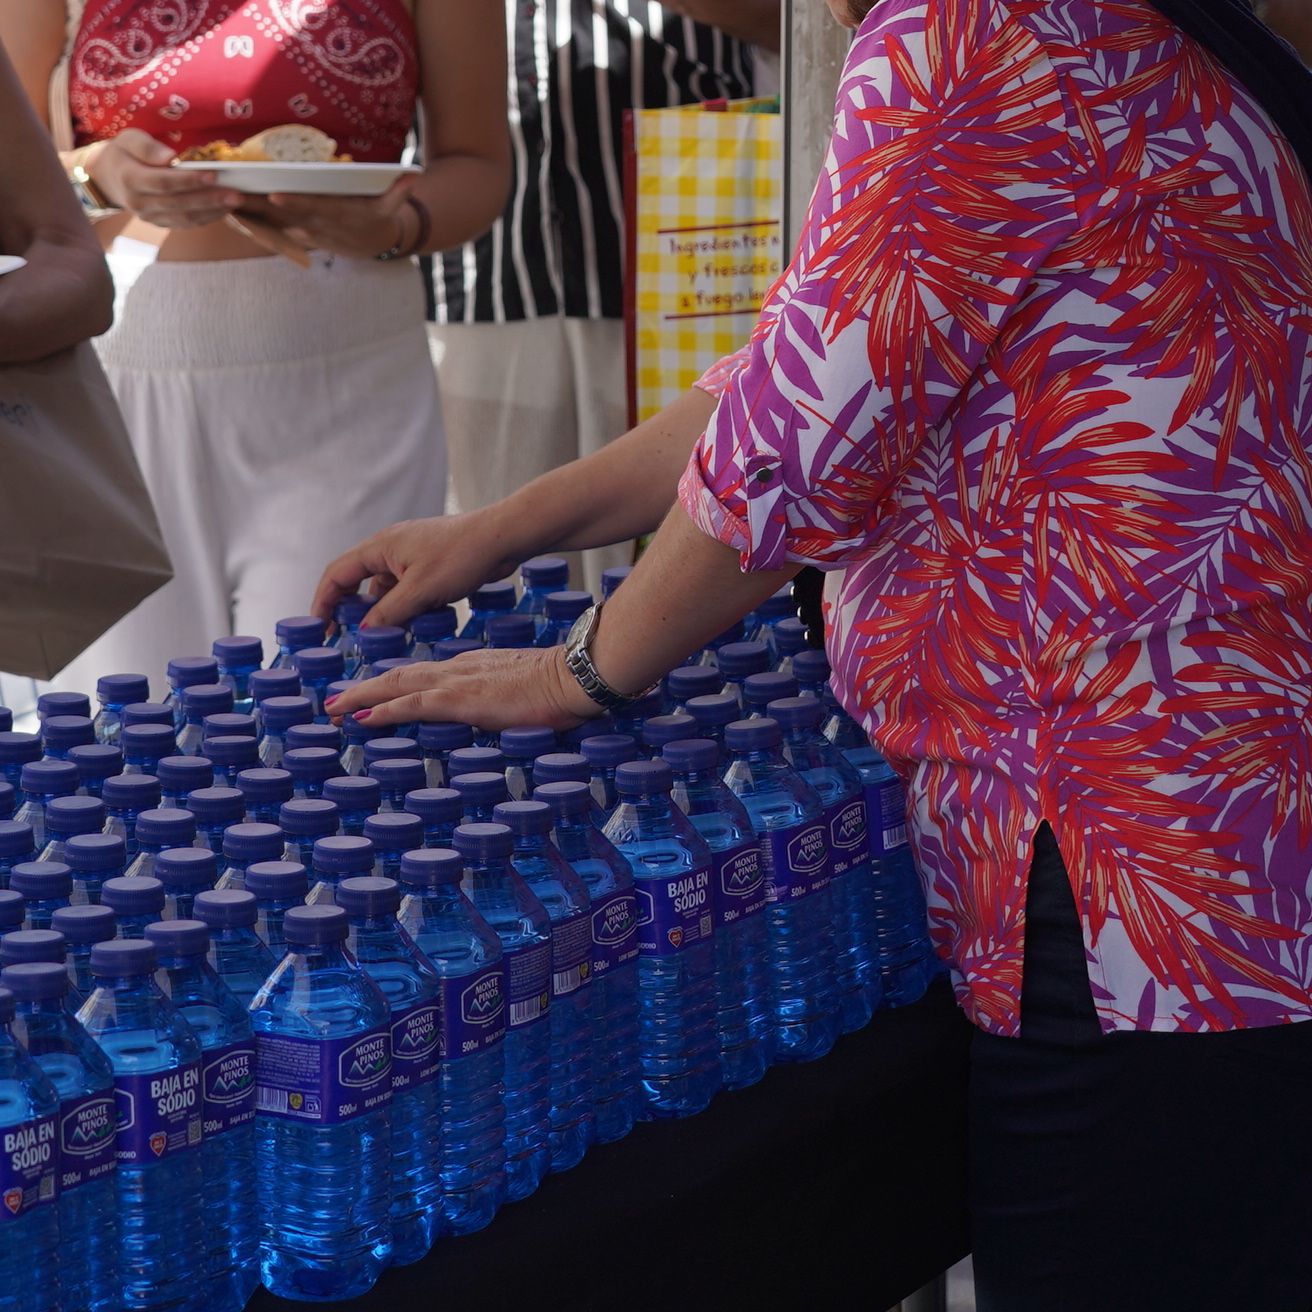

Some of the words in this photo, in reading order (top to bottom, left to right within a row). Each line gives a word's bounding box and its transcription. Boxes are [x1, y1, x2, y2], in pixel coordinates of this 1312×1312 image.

[842, 806, 862, 823] MONTE
[845, 815, 862, 833] PINOS
[801, 831, 822, 846] MONTE
[805, 839, 823, 854] PINOS
[735, 853, 757, 869] MONTE
[738, 862, 758, 877] PINOS
[668, 877, 694, 898] BAJA
[696, 871, 708, 888] EN
[606, 901, 628, 917] MONTE
[674, 889, 706, 913] SODIO
[609, 910, 629, 925] PINOS
[475, 977, 498, 994] MONTE
[478, 987, 498, 1003] PINOS
[408, 1012, 433, 1028] MONTE
[411, 1022, 434, 1038] PINOS
[356, 1038, 384, 1057] MONTE
[220, 1055, 248, 1073] MONTE
[360, 1049, 384, 1066] PINOS
[151, 1074, 181, 1098] BAJA
[184, 1068, 199, 1088] EN
[224, 1067, 248, 1082] PINOS
[158, 1089, 195, 1116] SODIO
[78, 1104, 107, 1122] MONTE
[82, 1115, 108, 1132] PINOS
[5, 1128, 37, 1153] BAJA
[39, 1121, 54, 1141] EN
[12, 1142, 51, 1171] SODIO
